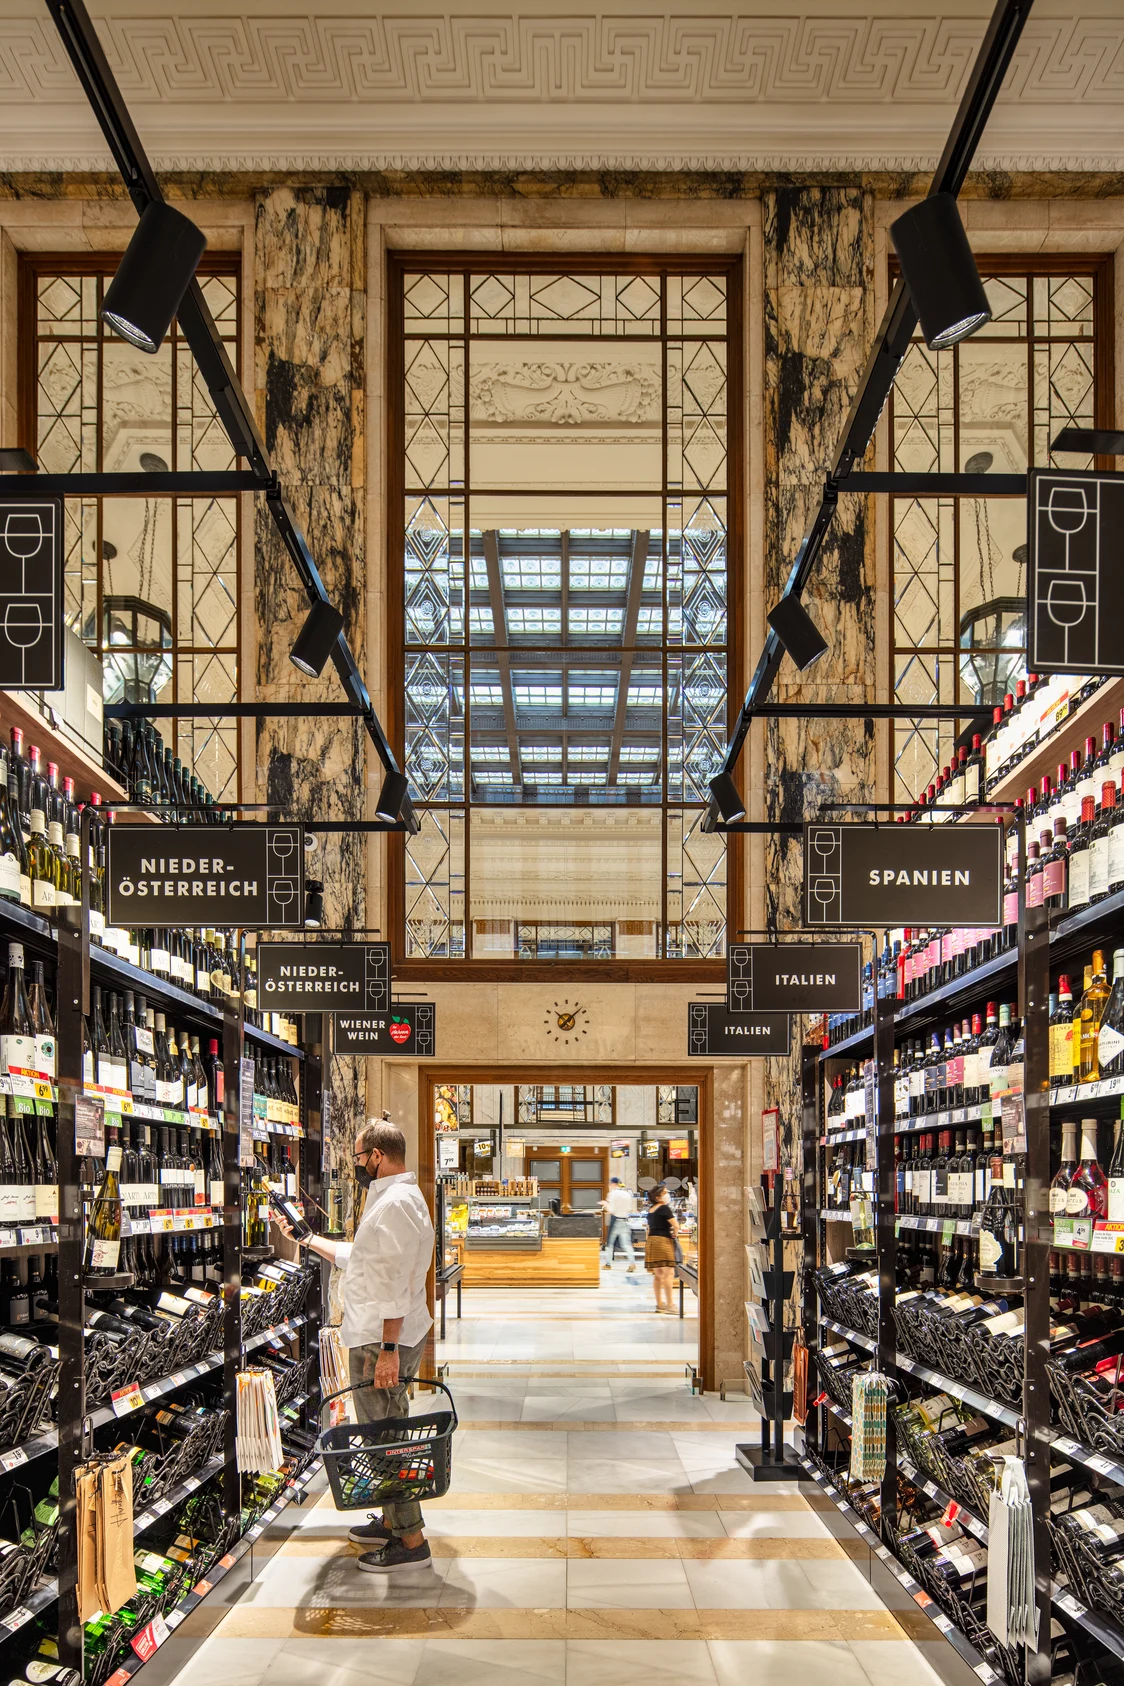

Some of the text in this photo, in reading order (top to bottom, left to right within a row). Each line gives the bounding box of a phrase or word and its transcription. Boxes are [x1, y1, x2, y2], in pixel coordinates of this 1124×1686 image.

[141, 858, 234, 874] NIEDER-
[868, 869, 970, 886] SPANIEN
[118, 876, 258, 897] ÖSTERREICH
[280, 965, 344, 977] NIEDER-
[264, 978, 360, 993] ÖSTERREICH
[775, 974, 836, 986] ITALIEN
[339, 1019, 386, 1029] WIENER
[347, 1031, 379, 1041] WEIN
[724, 1026, 771, 1035] ITALIEN
